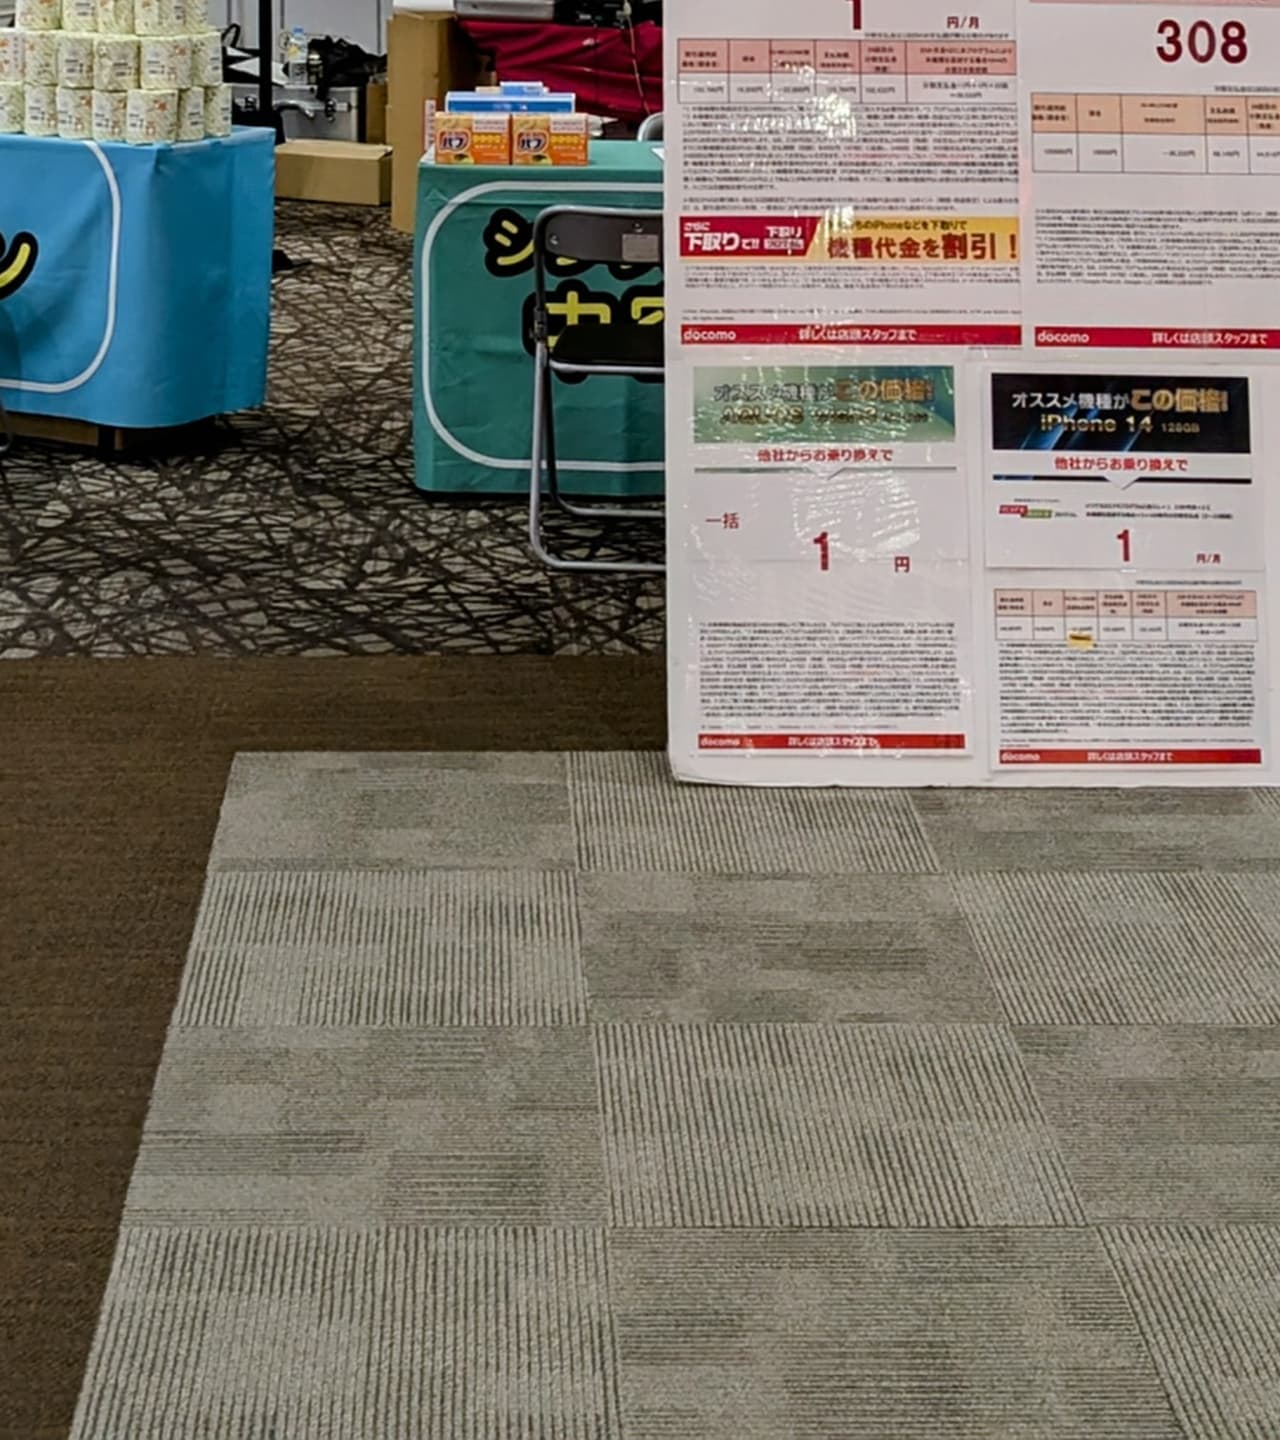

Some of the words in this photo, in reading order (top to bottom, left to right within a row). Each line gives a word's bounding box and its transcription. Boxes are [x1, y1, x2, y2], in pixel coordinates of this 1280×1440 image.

[946, 15, 980, 30] 円/月
[1156, 19, 1248, 65] 308
[765, 225, 802, 238] 下取り
[683, 327, 737, 341] docomo
[1037, 330, 1090, 344] docomo
[1040, 413, 1117, 433] iPhone
[1126, 413, 1153, 432] 14
[757, 448, 893, 463] 他社からお乗り換えで
[1054, 457, 1188, 471] 他社からお乗り換えで
[705, 512, 740, 530] 一括
[813, 531, 830, 571] 1
[1116, 528, 1131, 562] 1
[894, 555, 911, 573] 円
